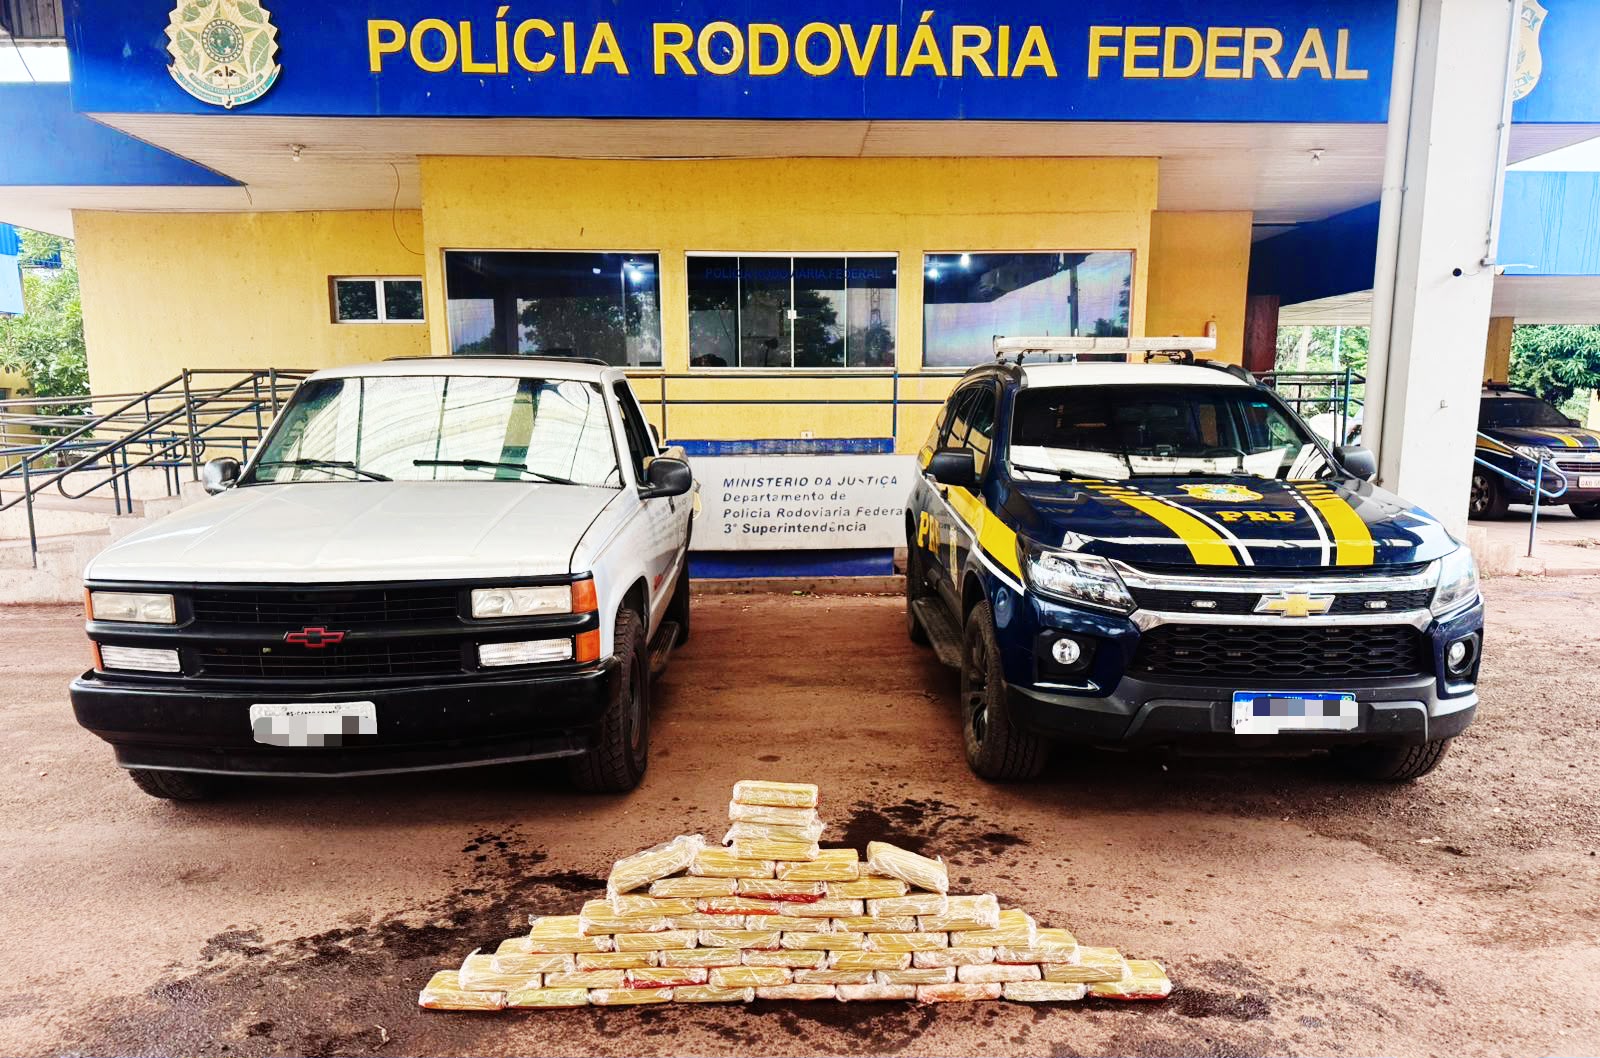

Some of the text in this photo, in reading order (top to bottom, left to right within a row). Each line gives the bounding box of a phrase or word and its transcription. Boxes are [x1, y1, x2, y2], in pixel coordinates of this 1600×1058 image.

[367, 5, 1369, 80] POLÍCIA RODOVIÁRIA FEDERAL
[723, 477, 809, 488] MINISTERIO
[723, 491, 846, 504] Departamento de
[1215, 511, 1296, 522] PRF
